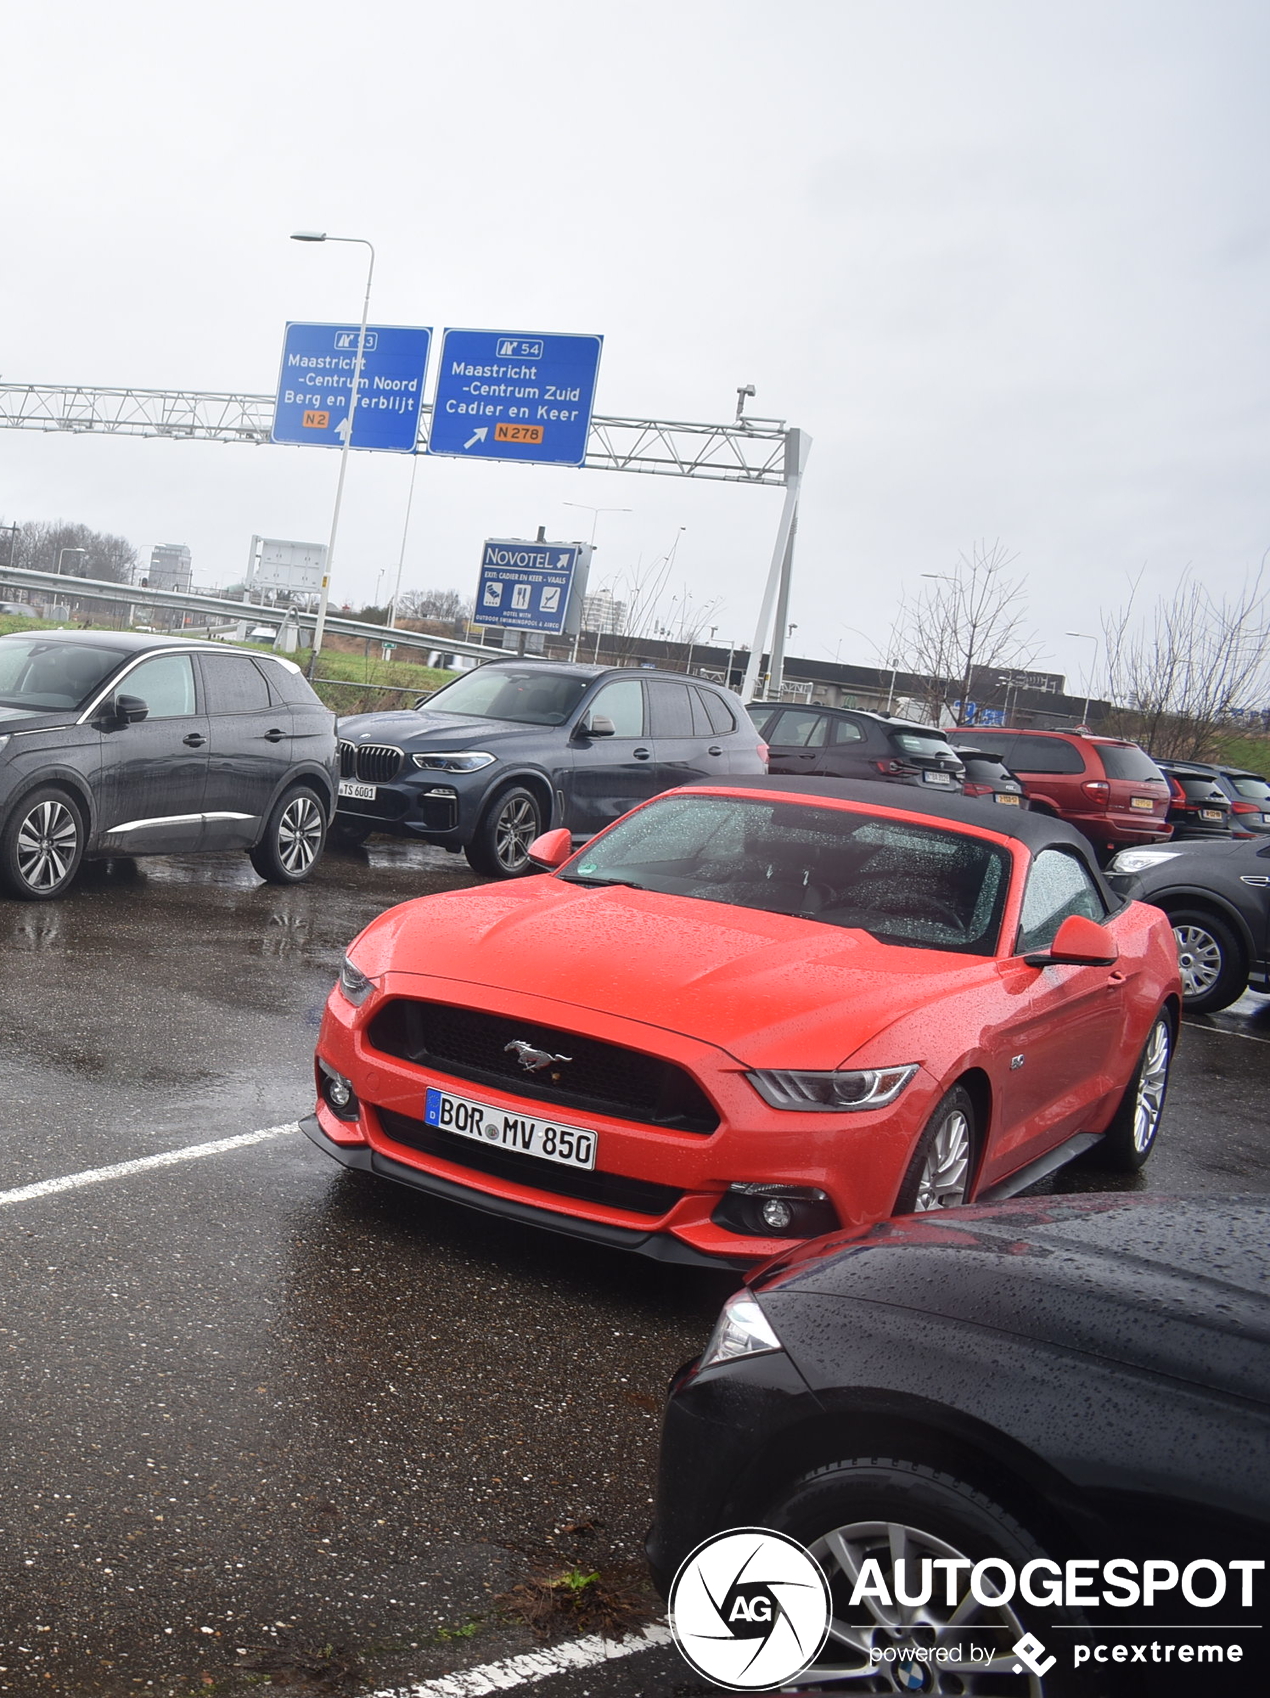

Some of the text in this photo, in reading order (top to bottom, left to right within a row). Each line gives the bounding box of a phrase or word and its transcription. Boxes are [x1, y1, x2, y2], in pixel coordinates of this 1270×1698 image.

[521, 344, 539, 355] 54
[288, 353, 366, 370] Maastricht
[452, 361, 537, 379] Maastricht
[298, 372, 418, 392] -Centrum Noord
[284, 390, 321, 409] Berg
[327, 395, 345, 406] en
[462, 382, 580, 401] -Centrum Zuid
[446, 400, 579, 421] Cadier en Keer
[485, 547, 553, 567] NOVOTEL
[499, 572, 519, 580] CADIER
[529, 574, 543, 582] KEER
[548, 576, 567, 584] VAALS
[476, 614, 499, 622] OUTDOOR
[344, 784, 373, 798] TS 6001
[430, 1111, 435, 1119] D
[441, 1098, 591, 1163] BOR MV 850
